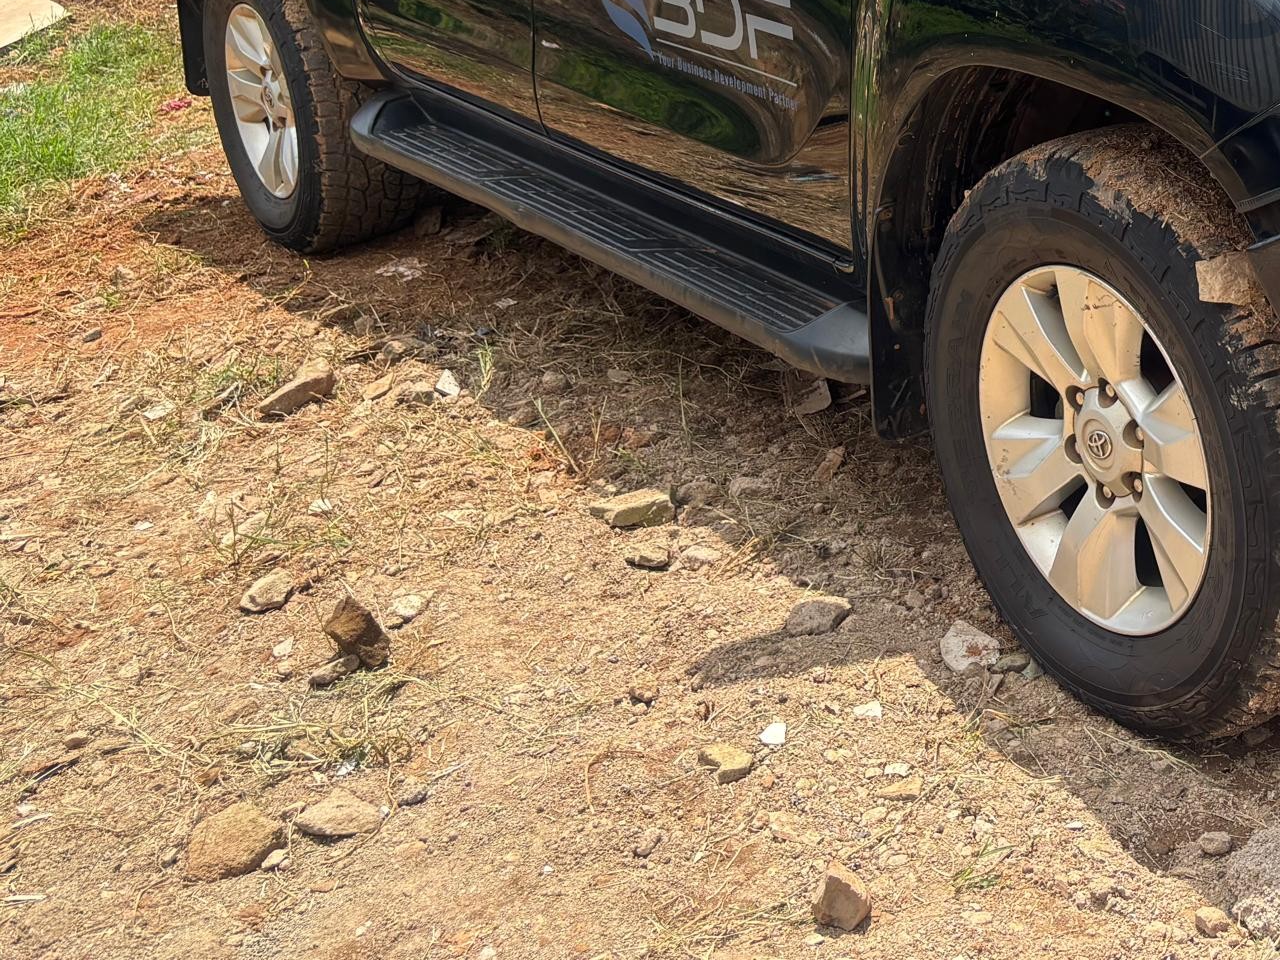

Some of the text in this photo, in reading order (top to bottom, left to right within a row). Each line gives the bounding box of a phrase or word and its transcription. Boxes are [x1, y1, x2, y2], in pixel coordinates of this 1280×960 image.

[677, 56, 712, 81] Business
[714, 69, 767, 100] Development
[769, 87, 798, 112] Partner
